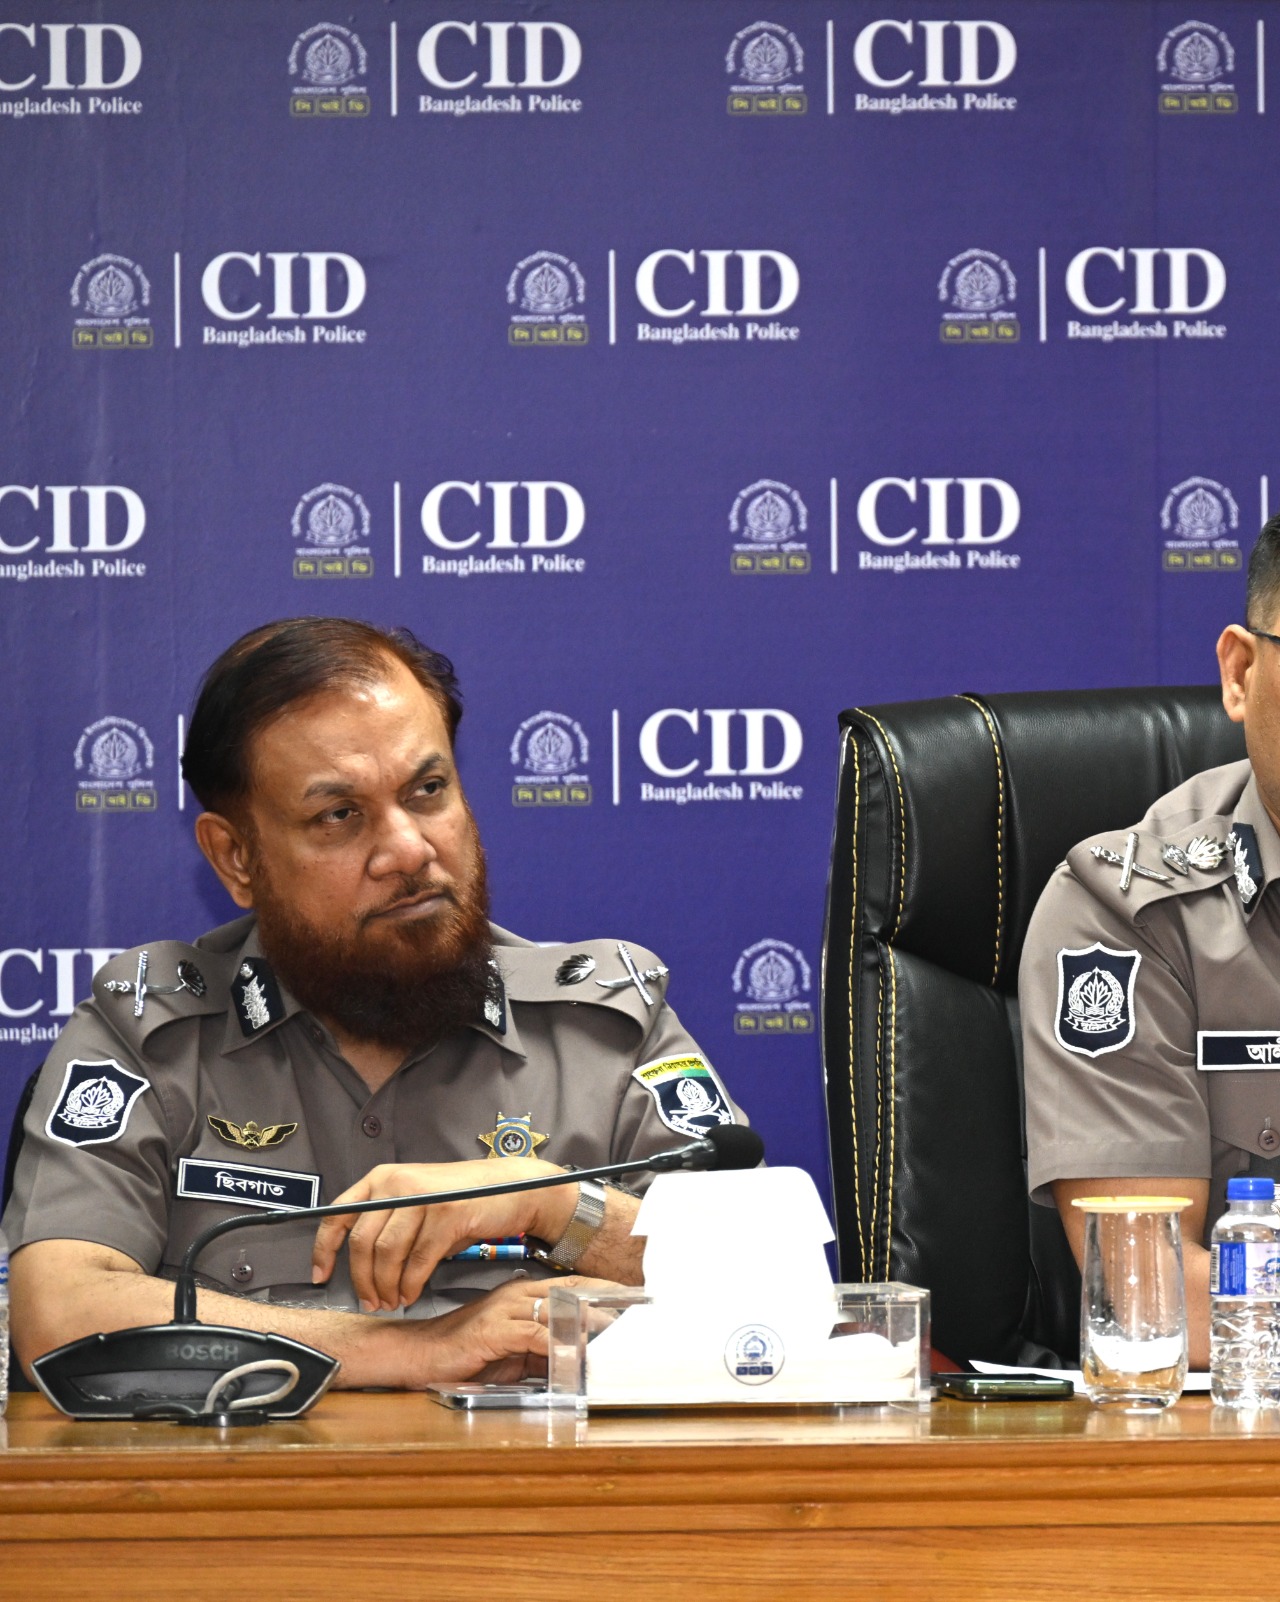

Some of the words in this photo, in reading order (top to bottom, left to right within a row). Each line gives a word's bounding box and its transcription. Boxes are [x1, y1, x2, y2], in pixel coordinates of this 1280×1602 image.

[0, 22, 143, 91] CID
[417, 20, 582, 90] CID
[853, 19, 1017, 88] CID
[0, 97, 82, 118] ngladesh
[88, 96, 143, 114] Police
[419, 94, 523, 116] Bangladesh
[528, 94, 582, 112] Police
[855, 93, 958, 115] Bangladesh
[963, 92, 1017, 110] Police
[201, 251, 367, 321] CID
[635, 248, 800, 318] CID
[1065, 246, 1227, 315] CID
[202, 325, 307, 347] Bangladesh
[312, 325, 367, 343] Police
[637, 322, 740, 344] Bangladesh
[746, 322, 800, 340] Police
[1067, 320, 1168, 342] Bangladesh
[1173, 320, 1227, 338] Police
[0, 484, 146, 555] CID
[420, 480, 586, 550] CID
[857, 476, 1021, 546] CID
[0, 559, 85, 581] ngladesh
[92, 558, 146, 577] Police
[422, 554, 526, 577] Bangladesh
[531, 553, 586, 573] Police
[858, 550, 962, 573] Bangladesh
[967, 550, 1021, 569] Police
[639, 708, 803, 778] CID
[640, 781, 744, 804] Bangladesh
[749, 781, 803, 800] Police
[0, 947, 128, 1018] CI
[0, 1021, 63, 1046] anglad
[214, 1171, 287, 1198] ছিবগাত
[165, 1343, 239, 1361] BOSCH
